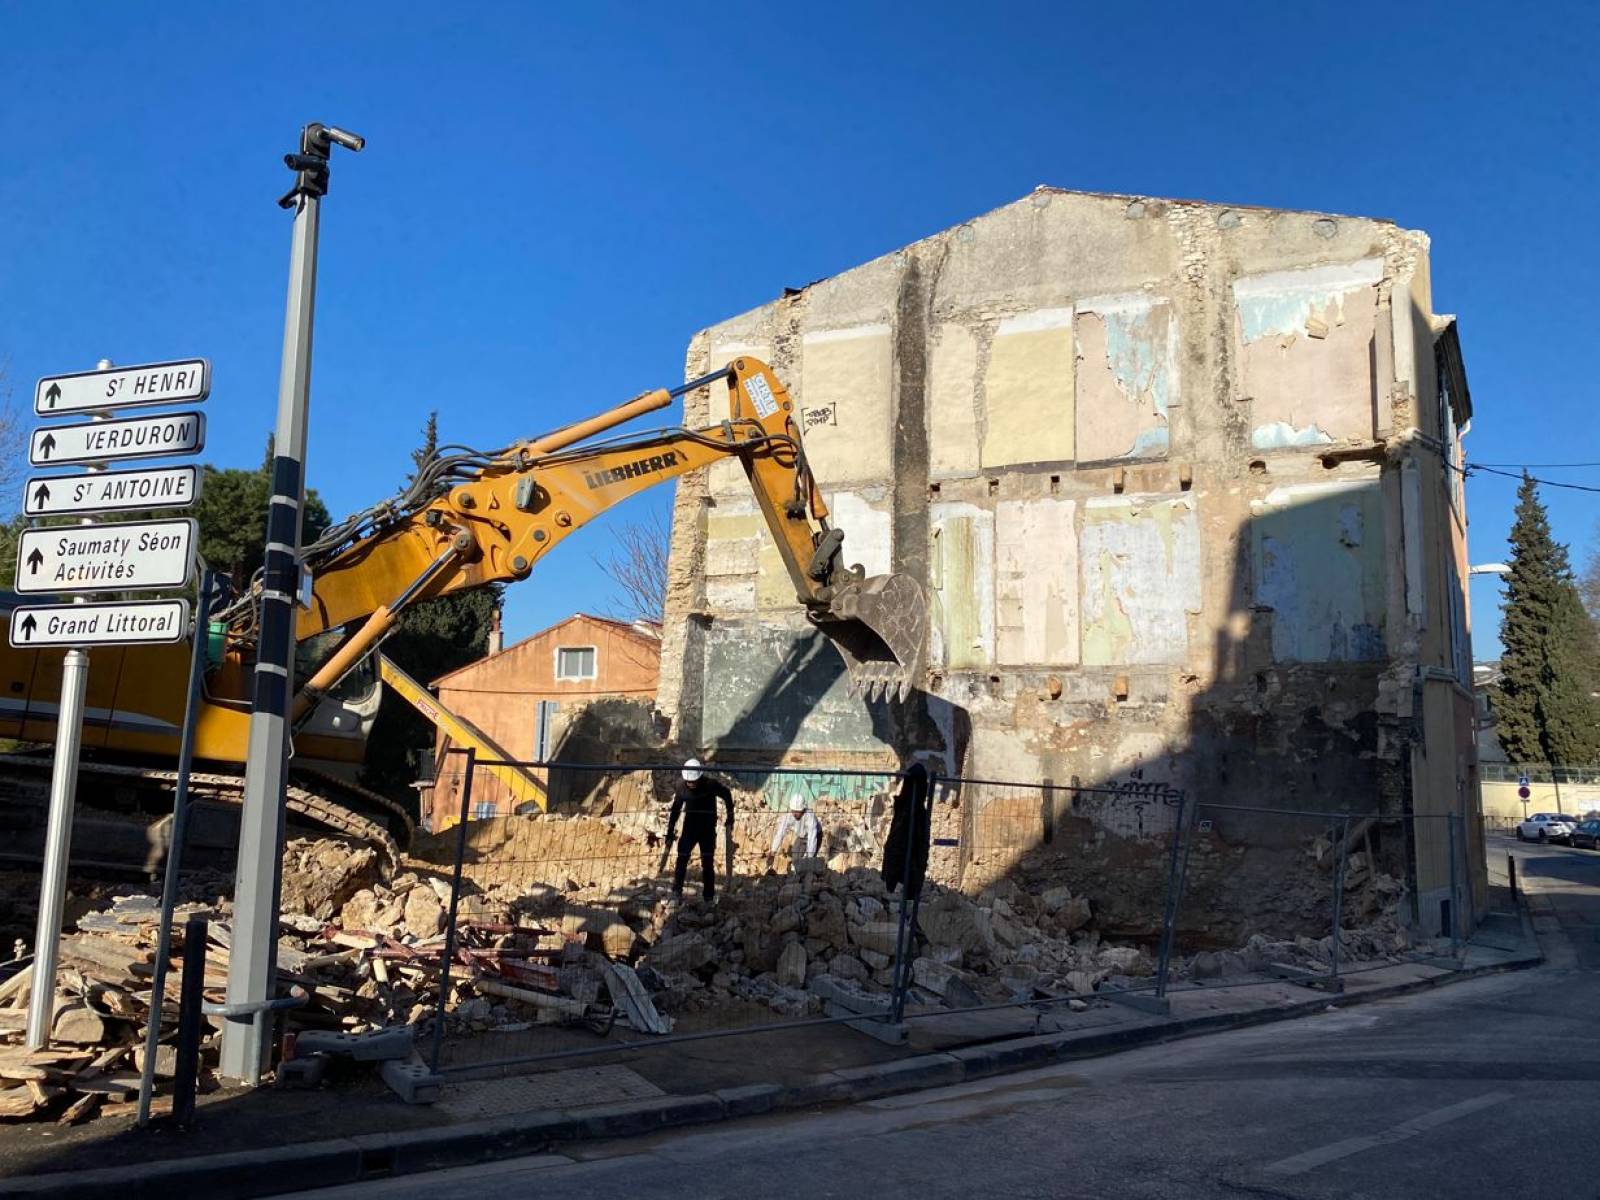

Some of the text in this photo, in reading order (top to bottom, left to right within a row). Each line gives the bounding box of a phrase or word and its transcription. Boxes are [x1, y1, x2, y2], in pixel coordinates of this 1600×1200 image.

[134, 370, 196, 395] HENRI
[85, 423, 191, 450] VERDURON
[585, 451, 679, 490] LIEBHERR
[101, 475, 187, 501] ANTOINE
[57, 531, 182, 557] Saumaty Séon
[54, 560, 136, 582] Activités
[47, 611, 174, 635] Grand Littoral
